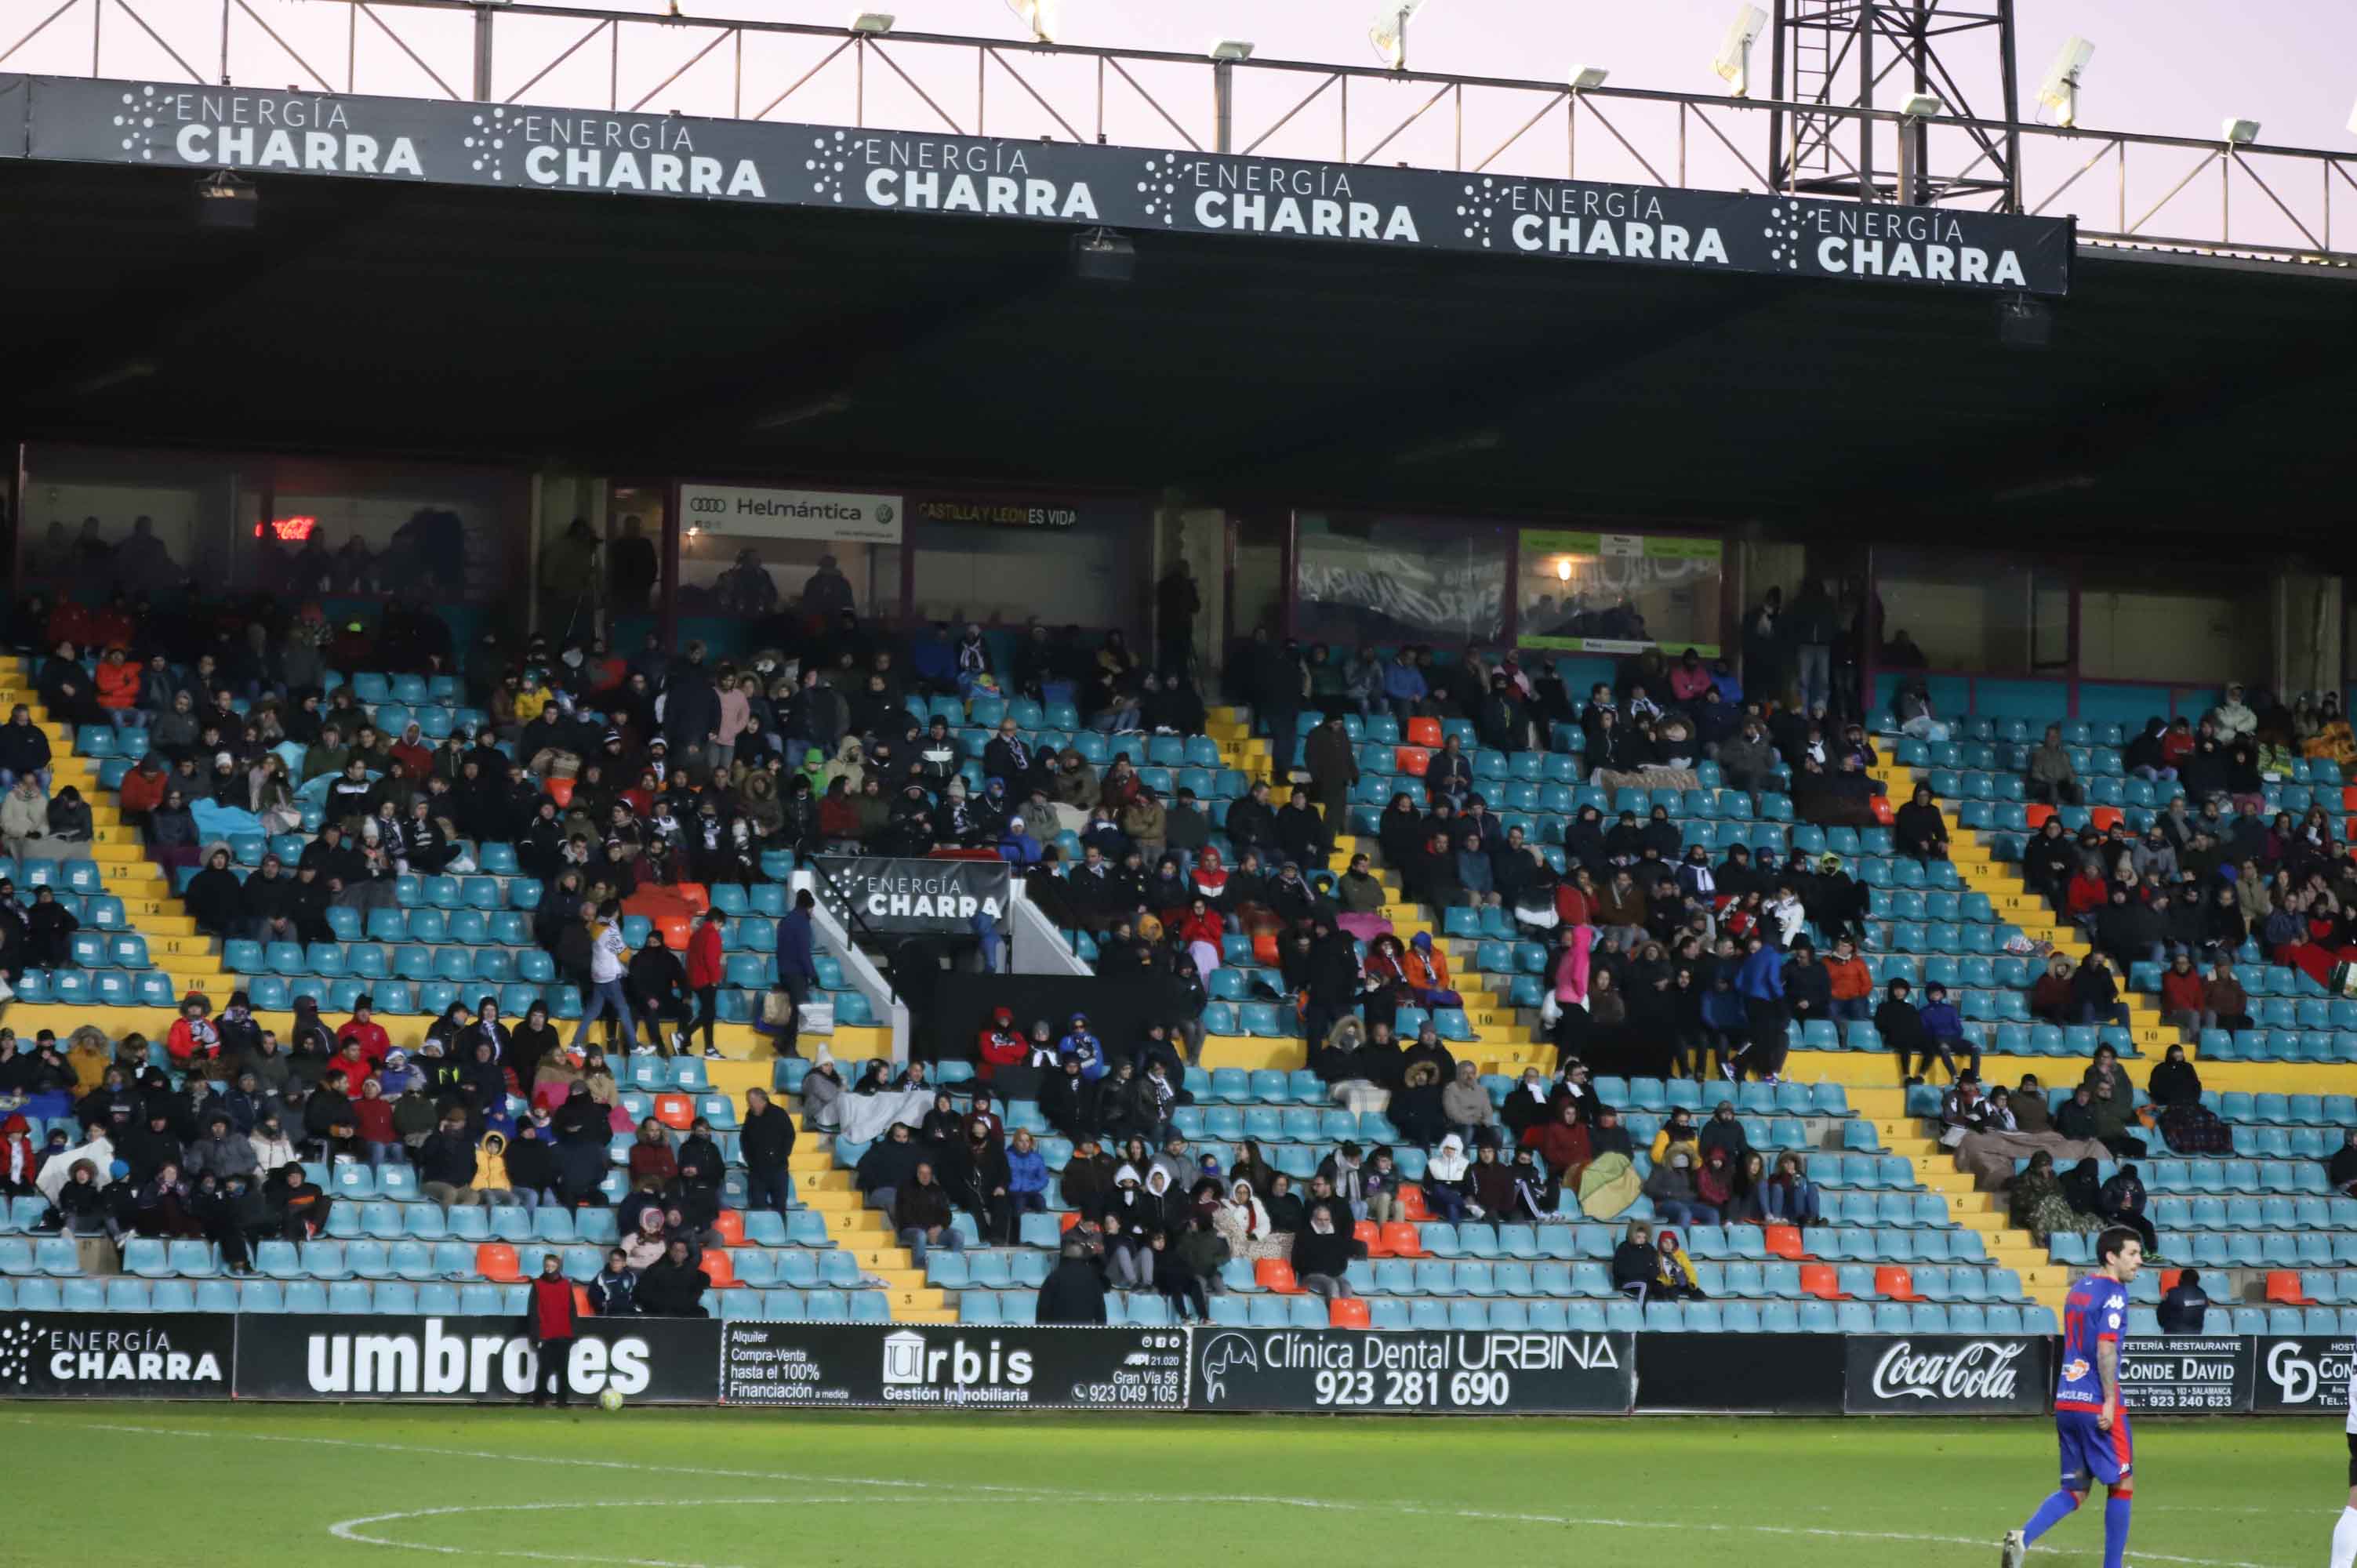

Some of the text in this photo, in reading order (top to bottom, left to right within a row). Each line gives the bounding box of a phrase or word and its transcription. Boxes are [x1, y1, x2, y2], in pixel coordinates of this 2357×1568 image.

[176, 94, 349, 130] ENERGÍA
[527, 115, 694, 152] ENERGÍA
[176, 123, 424, 176] CHARRA
[866, 139, 1029, 175] ENERGÍA
[525, 145, 766, 198] CHARRA
[1196, 162, 1353, 198] ENERGÍA
[865, 168, 1099, 220] CHARRA
[1512, 186, 1664, 221] ENERGÍA
[1195, 191, 1421, 242] CHARRA
[1818, 209, 1963, 244] ENERGÍA
[1512, 214, 1729, 264] CHARRA
[1818, 237, 2027, 286] CHARRA
[736, 497, 862, 521] Helmántica
[1028, 508, 1044, 524] ES
[1047, 509, 1077, 526] VIDA
[867, 875, 961, 895] ENERGÍA
[867, 893, 1002, 919] CHARRA
[51, 1327, 171, 1353] ENERGÍA
[731, 1330, 768, 1345] Alquiler
[1263, 1333, 1618, 1370] Clínica Dental URBINA
[2123, 1341, 2164, 1352] FETERÍA
[2170, 1341, 2243, 1351] RESTAURANTE
[50, 1352, 223, 1382] CHARRA
[731, 1348, 807, 1364] Compra-Venta
[883, 1330, 1034, 1385] Urbis
[1150, 1356, 1179, 1367] 21.020
[1872, 1341, 2028, 1399] Coca-Cola
[2182, 1357, 2235, 1380] DAVID
[2319, 1357, 2352, 1379] CON
[731, 1363, 820, 1381] hasta el 100%
[1113, 1370, 1140, 1385] Gran
[1164, 1371, 1179, 1385] 56
[730, 1381, 812, 1399] Financiación
[822, 1388, 849, 1399] medida
[883, 1386, 1030, 1402] Gestión Inmobiliaria
[1089, 1385, 1178, 1403] 923 049 105
[1316, 1371, 1509, 1406] 923 281 690
[2123, 1396, 2232, 1407] EL.: 923 240 623
